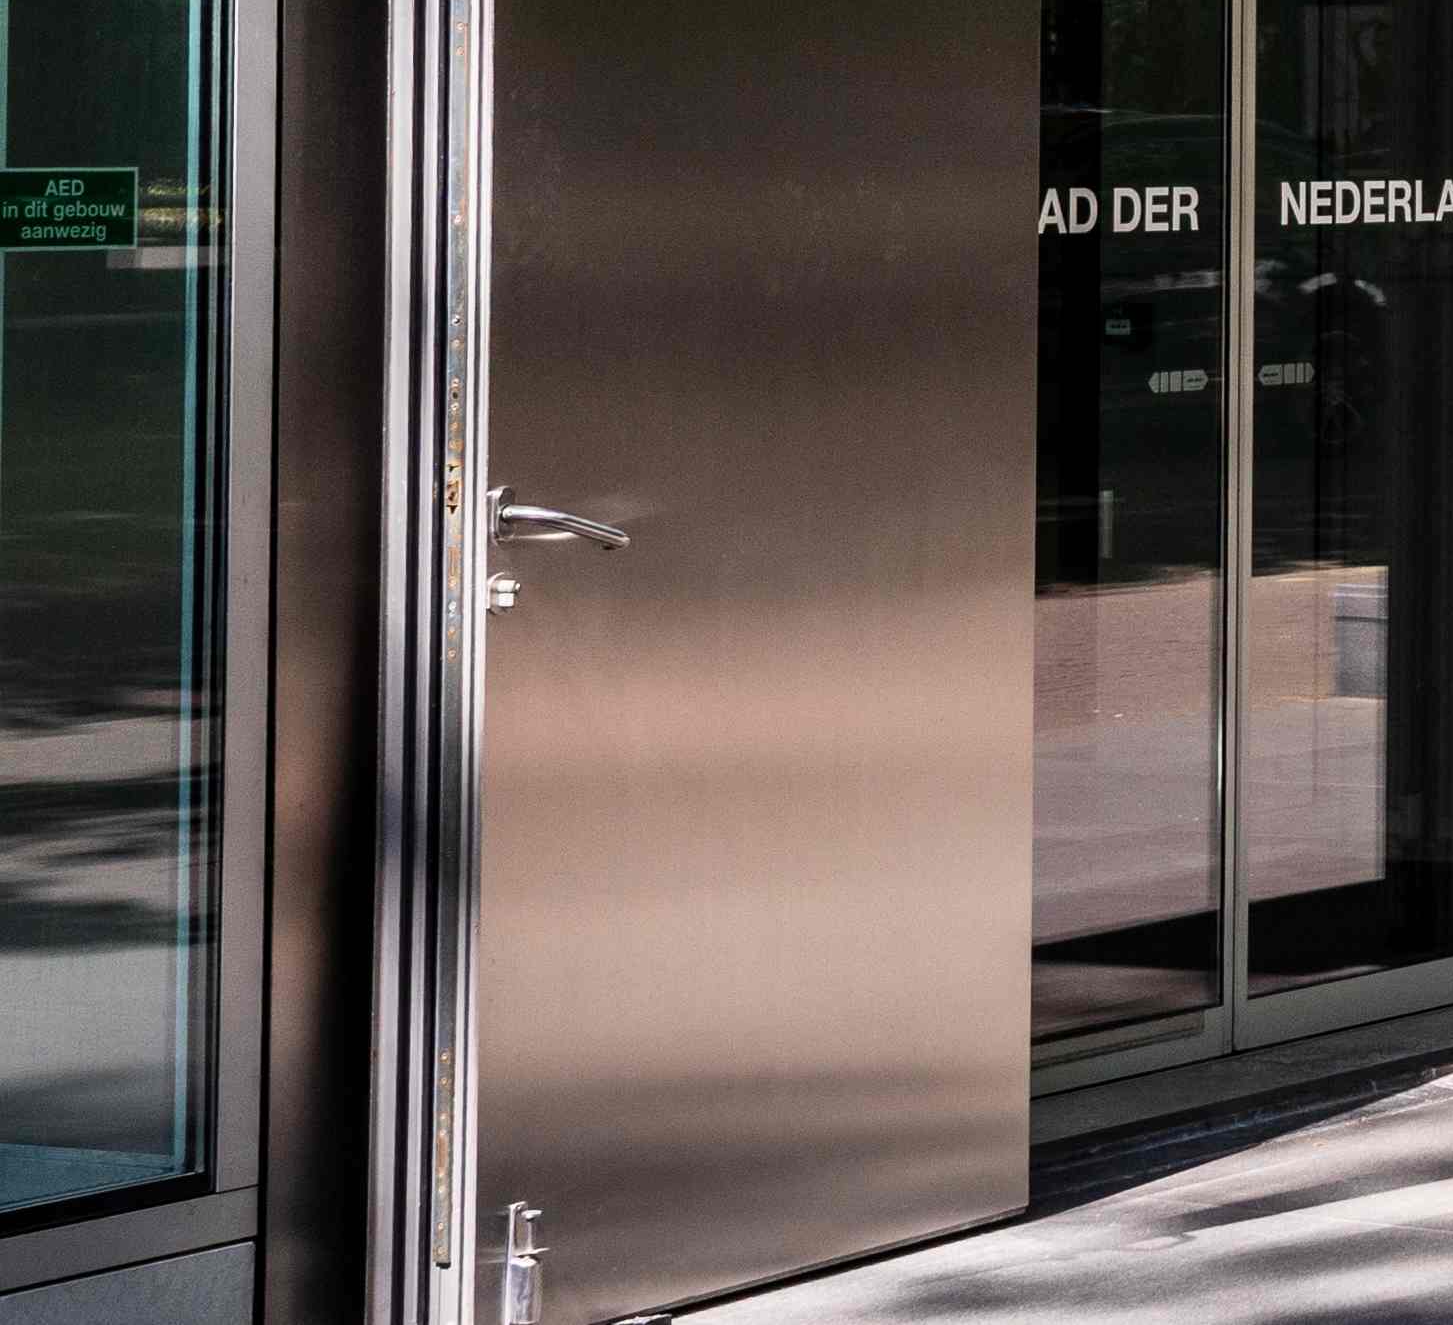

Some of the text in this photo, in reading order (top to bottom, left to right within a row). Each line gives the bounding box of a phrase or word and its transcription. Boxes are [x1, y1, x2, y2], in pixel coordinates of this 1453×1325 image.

[44, 179, 84, 197] AED
[2, 200, 126, 222] in dit gebouw
[1112, 185, 1200, 233] DER
[20, 222, 107, 241] aanwezig
